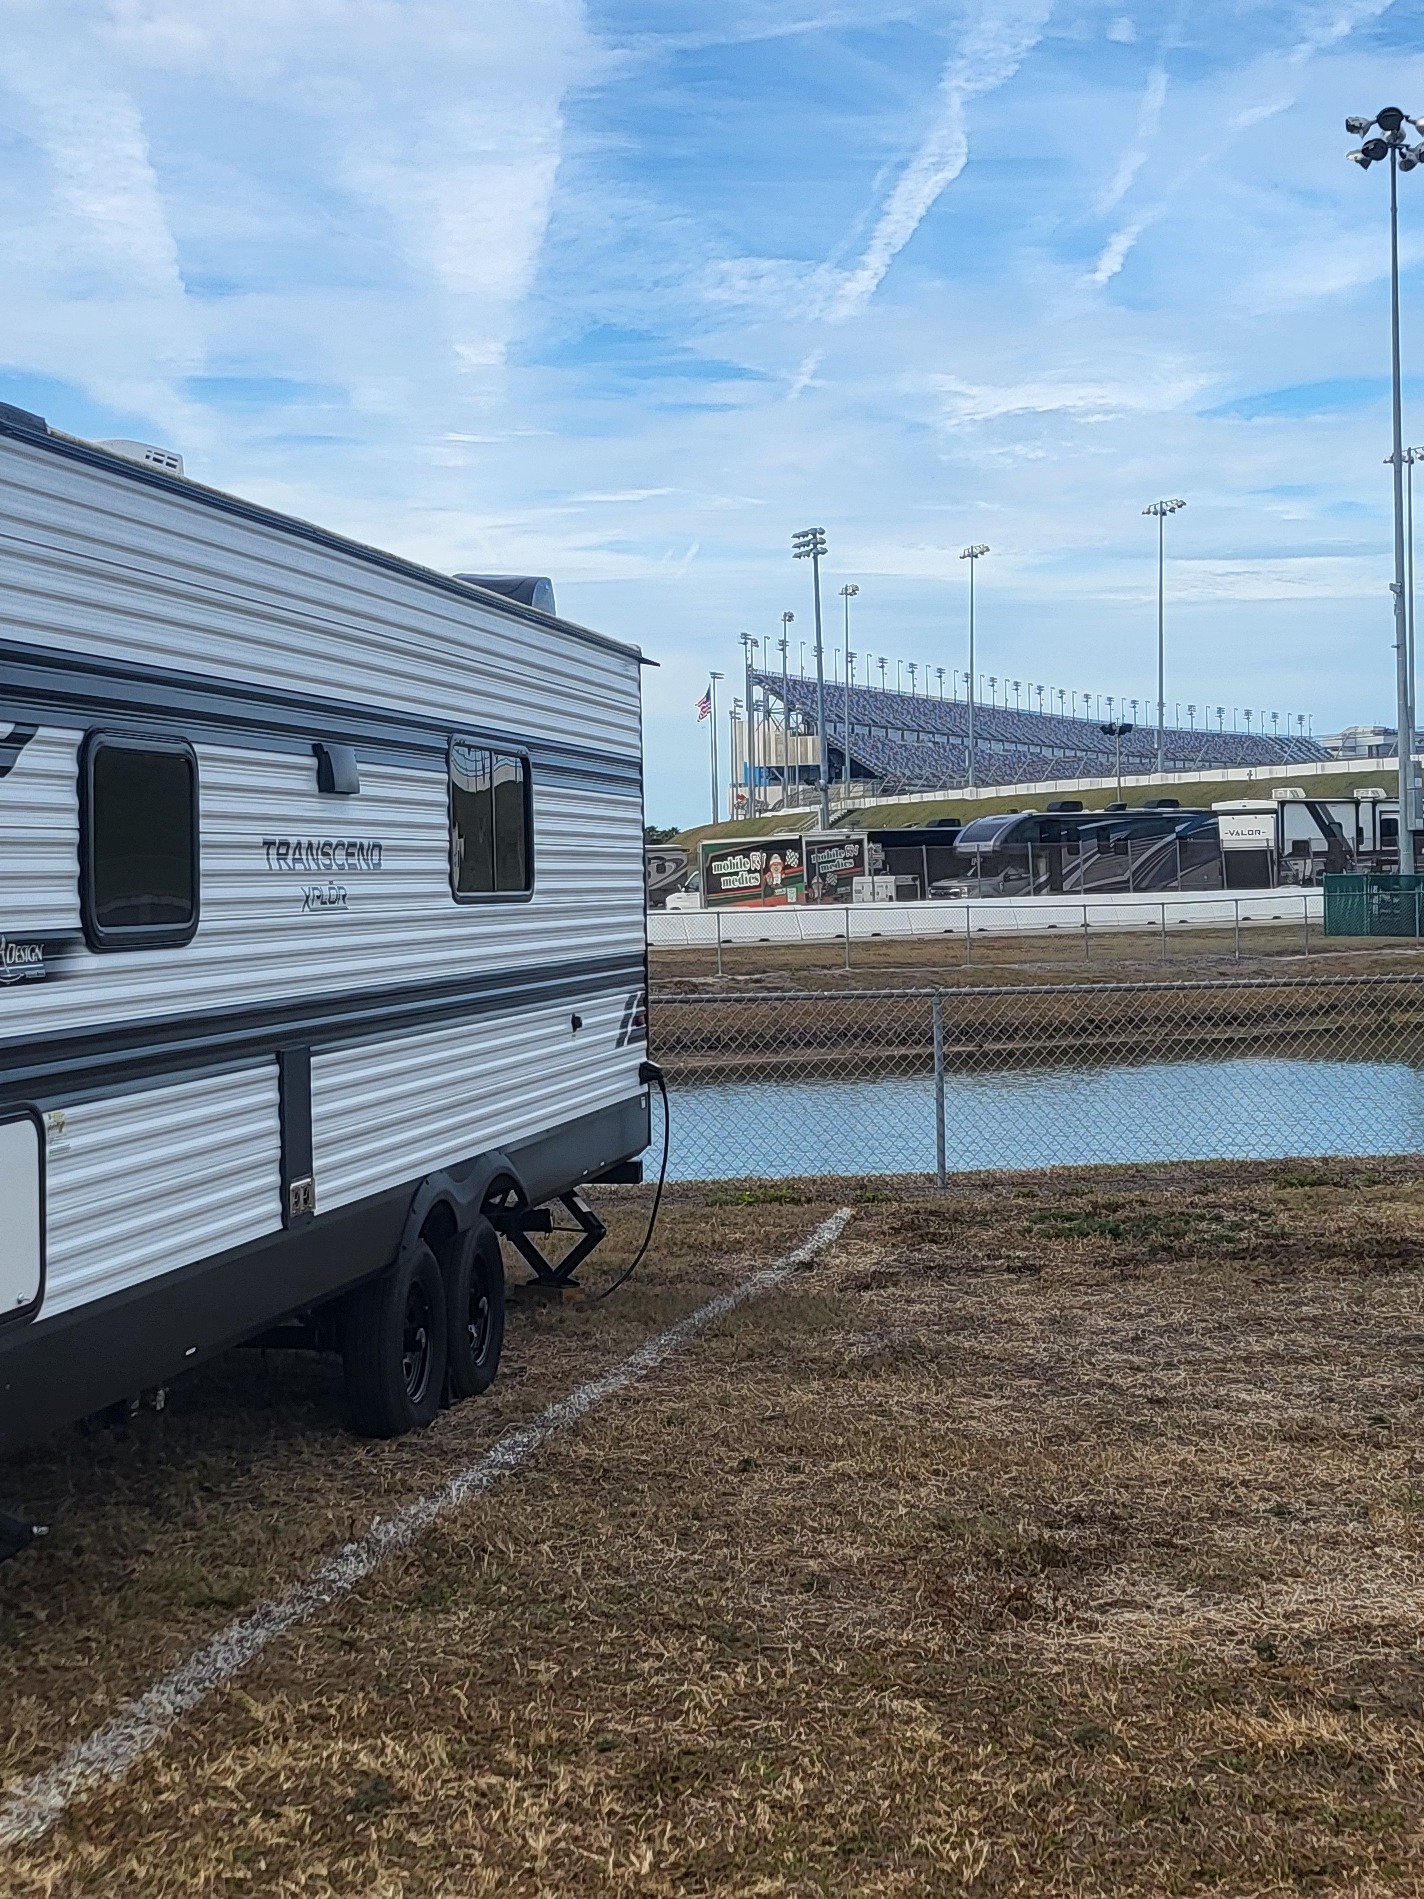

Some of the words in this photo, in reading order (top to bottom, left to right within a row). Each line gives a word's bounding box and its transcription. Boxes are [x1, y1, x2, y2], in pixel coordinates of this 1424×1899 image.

[262, 838, 383, 871] TRANSCEND
[712, 855, 750, 874] mobile
[750, 852, 766, 870] RV
[811, 847, 846, 863] mobile
[845, 844, 859, 858] RV
[820, 858, 854, 873] medics
[721, 871, 760, 889] medics
